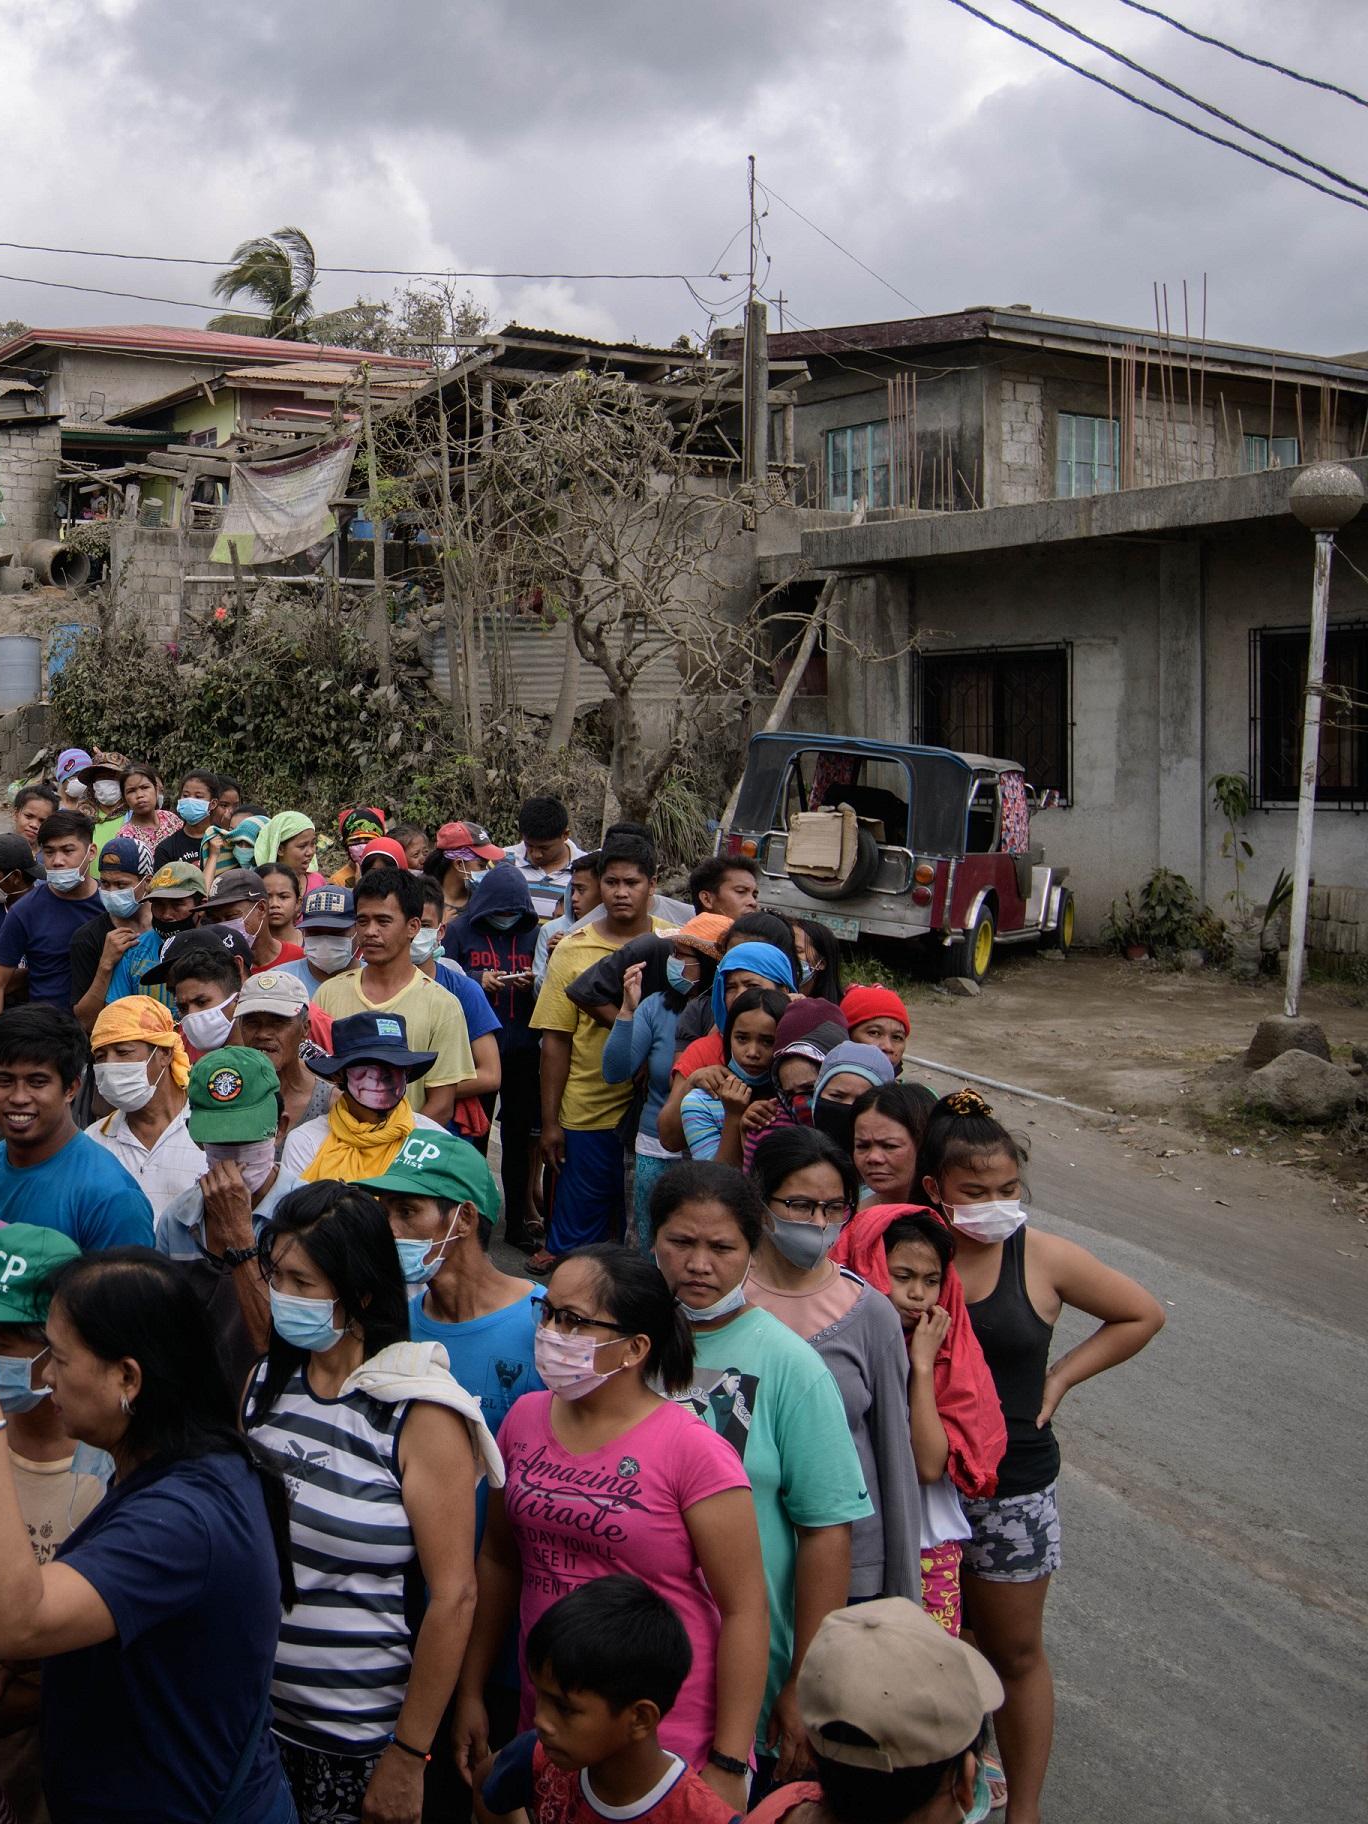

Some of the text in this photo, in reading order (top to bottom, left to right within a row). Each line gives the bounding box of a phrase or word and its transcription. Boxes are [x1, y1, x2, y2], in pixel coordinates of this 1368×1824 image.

[516, 1445, 644, 1507] Amazing
[527, 1527, 556, 1547] DAY
[559, 1534, 617, 1561] YOU'LL
[532, 1547, 579, 1570] SEE IT
